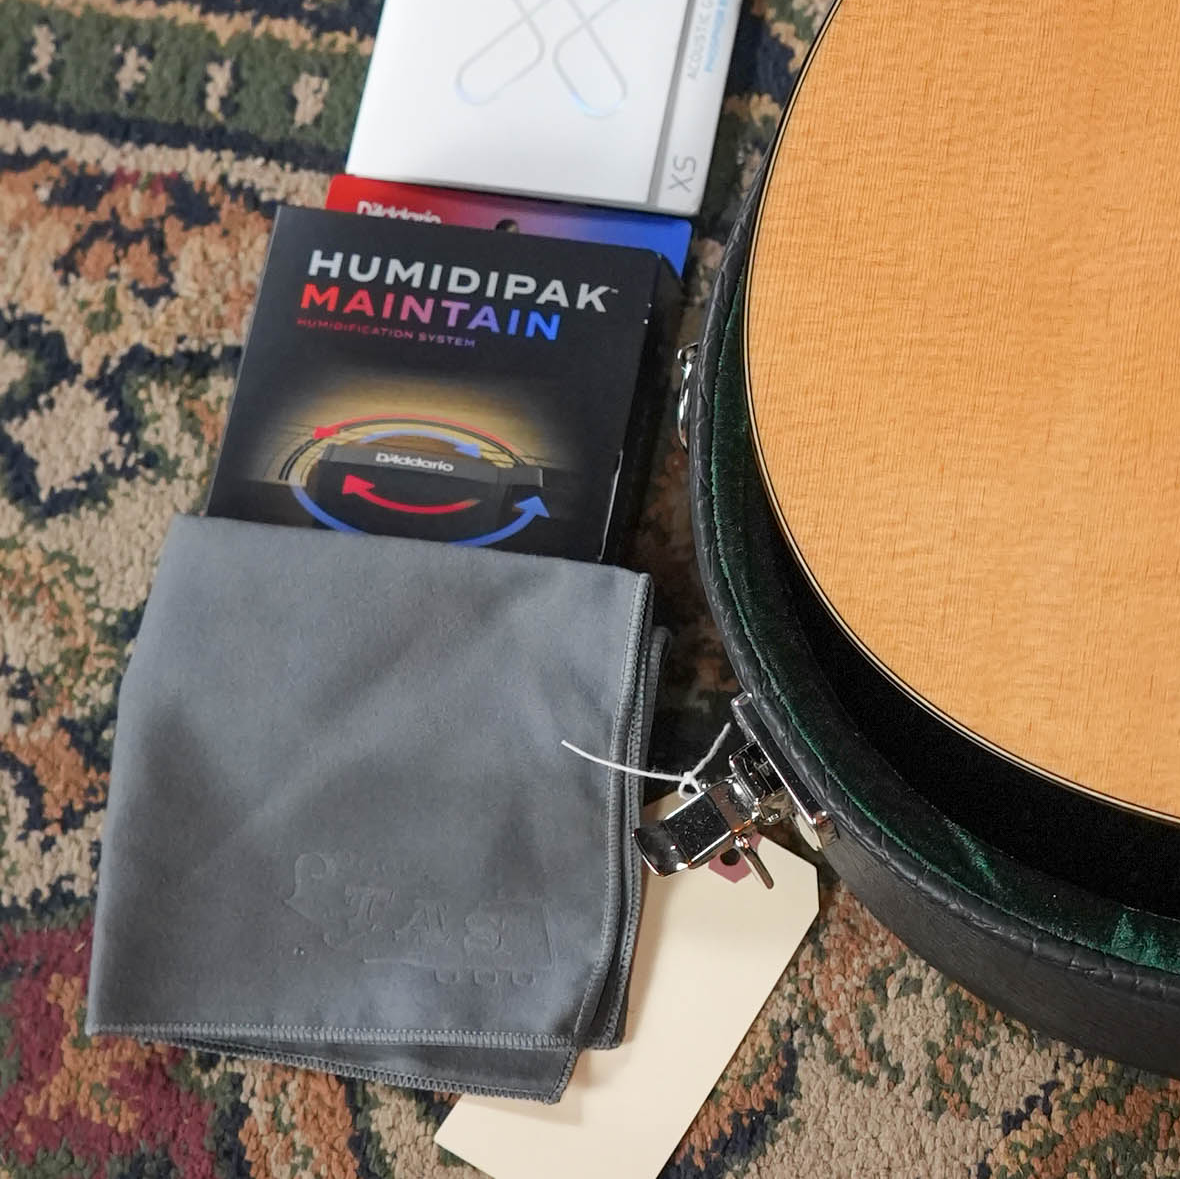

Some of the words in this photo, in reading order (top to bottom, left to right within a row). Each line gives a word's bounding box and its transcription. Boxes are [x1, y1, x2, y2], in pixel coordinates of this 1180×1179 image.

[669, 154, 697, 194] XS
[300, 283, 561, 341] MAINTAIN
[296, 317, 414, 341] HUMIDIFICATION
[417, 331, 476, 348] SYSTEM
[375, 452, 454, 472] D'Addario
